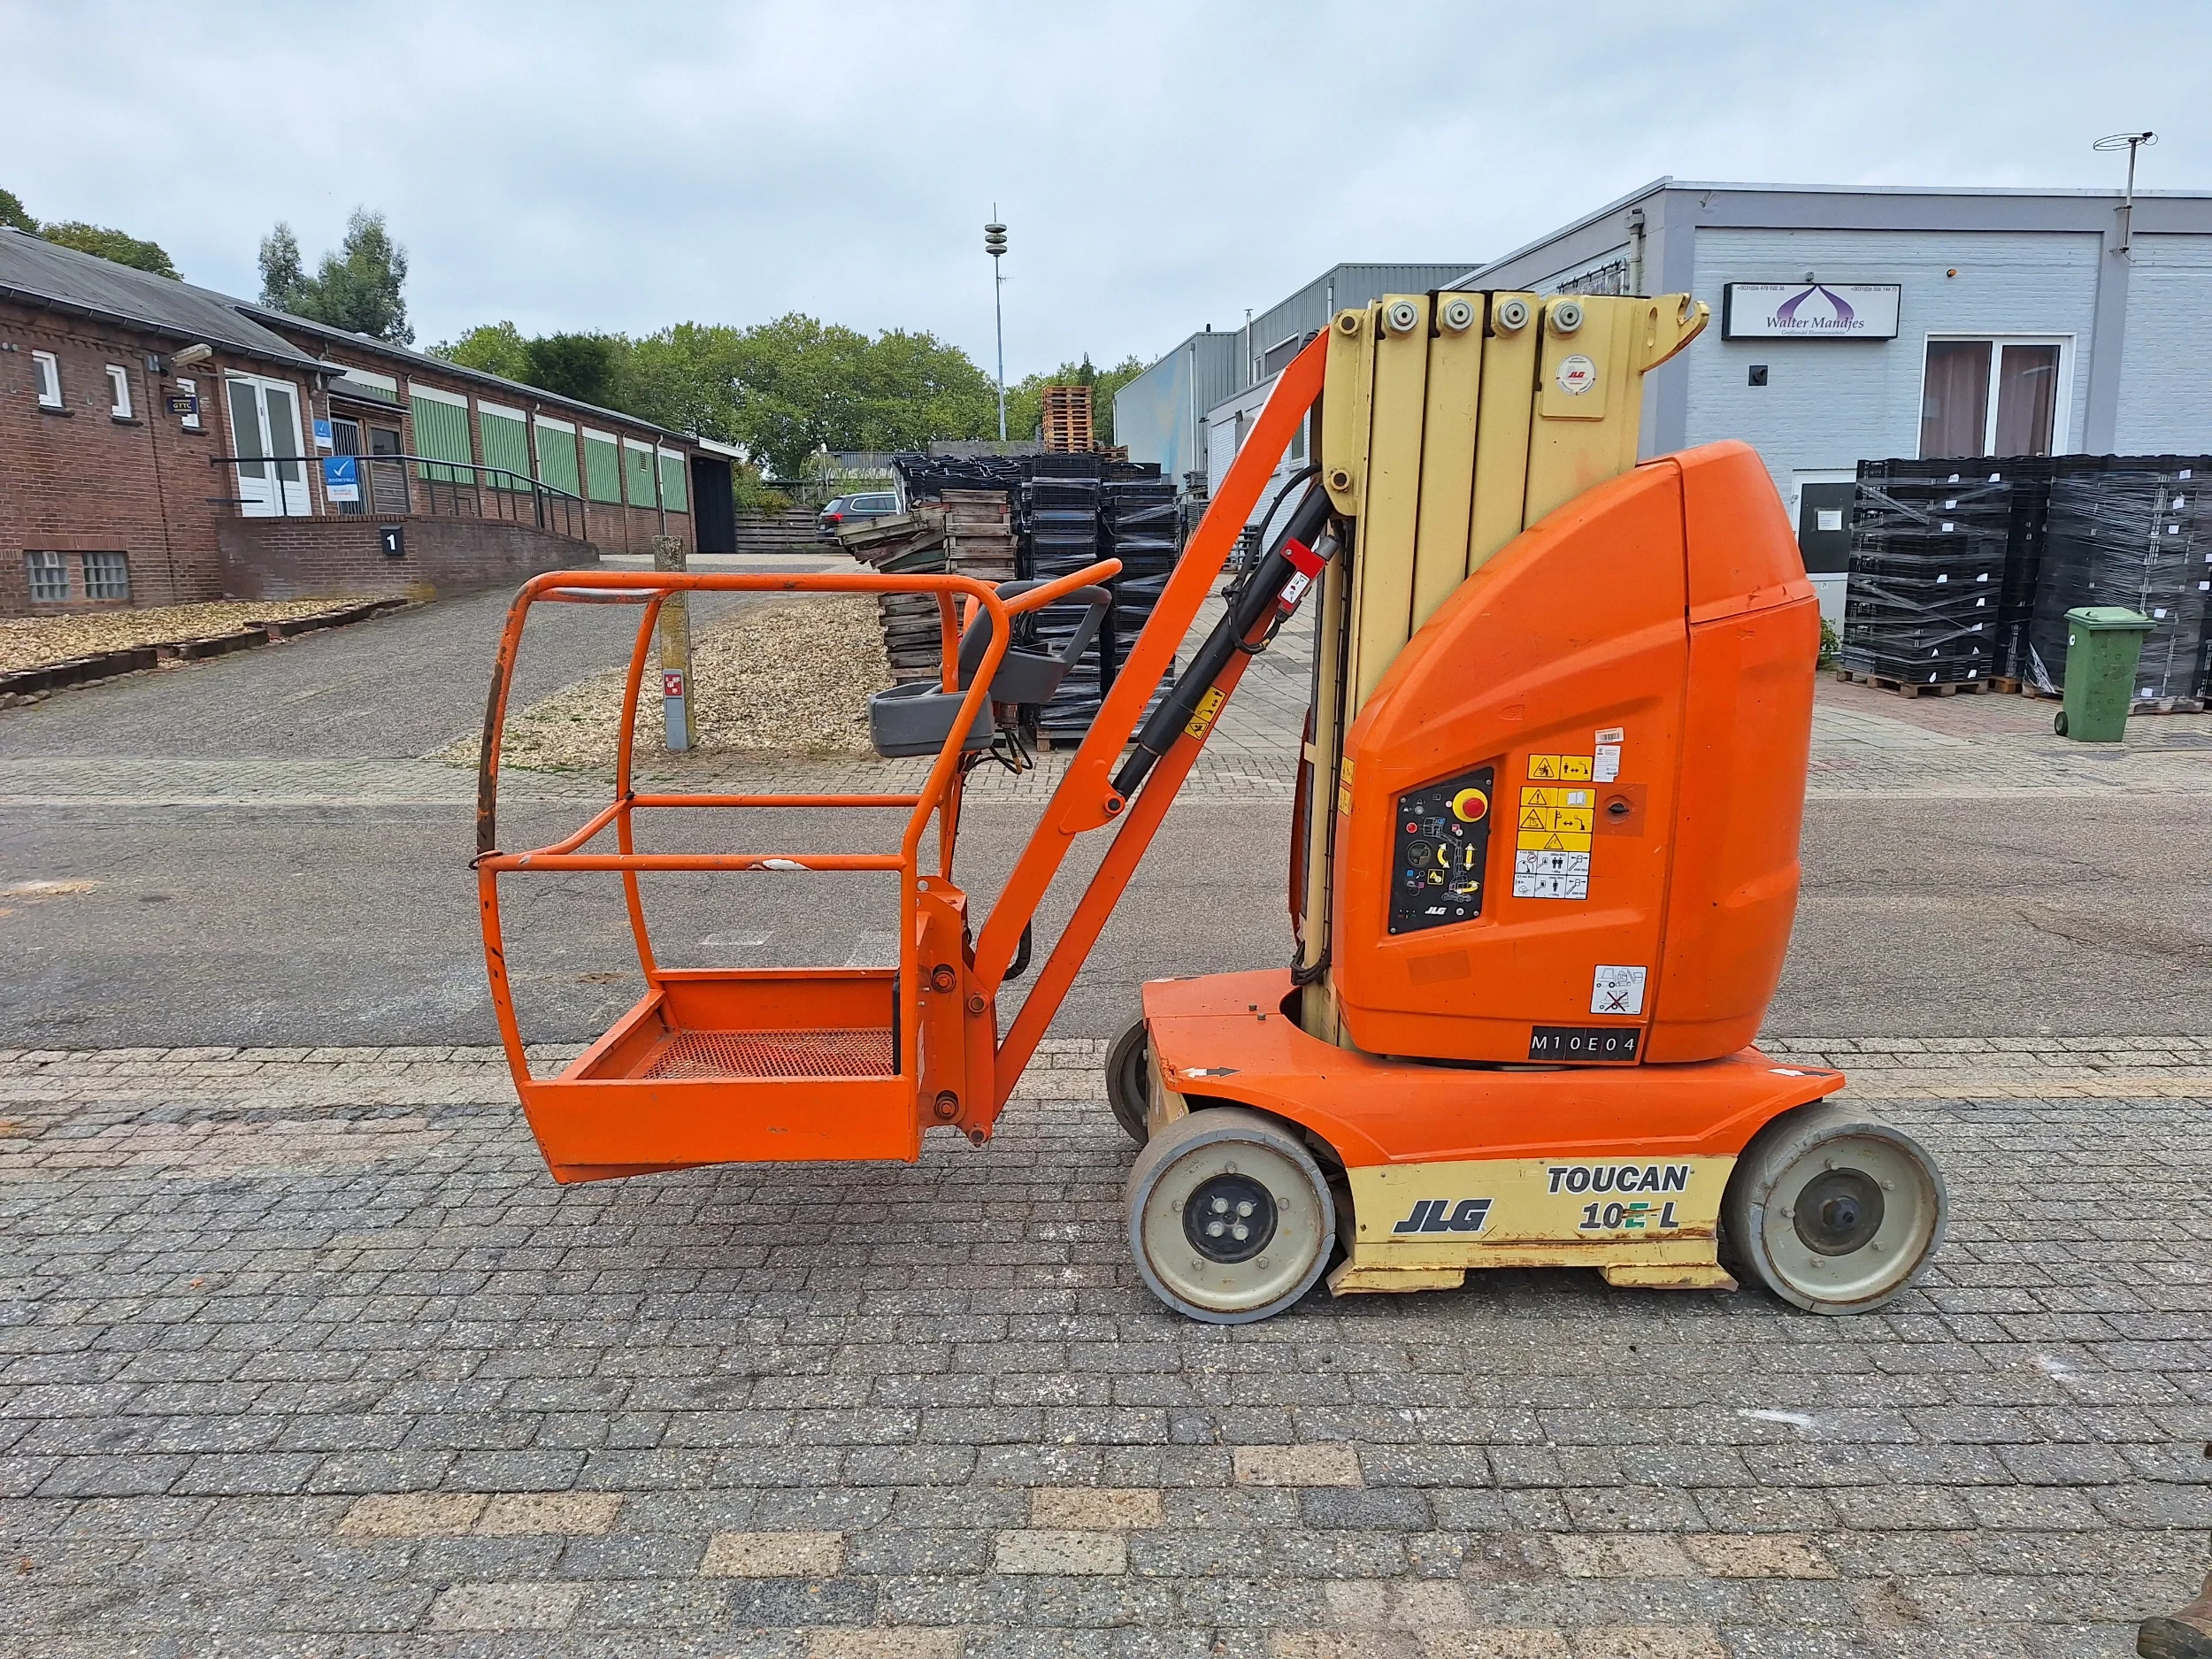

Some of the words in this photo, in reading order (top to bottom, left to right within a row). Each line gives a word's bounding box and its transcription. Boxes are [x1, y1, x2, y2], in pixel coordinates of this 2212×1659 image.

[1766, 316, 1809, 328] Walter
[1811, 316, 1865, 333] Mandjes
[386, 534, 396, 550] 1
[1425, 906, 1448, 915] JLG
[1548, 1165, 1690, 1194] TOUCAN
[1392, 1198, 1493, 1233] JLG
[1579, 1202, 1679, 1229] 10E-L
